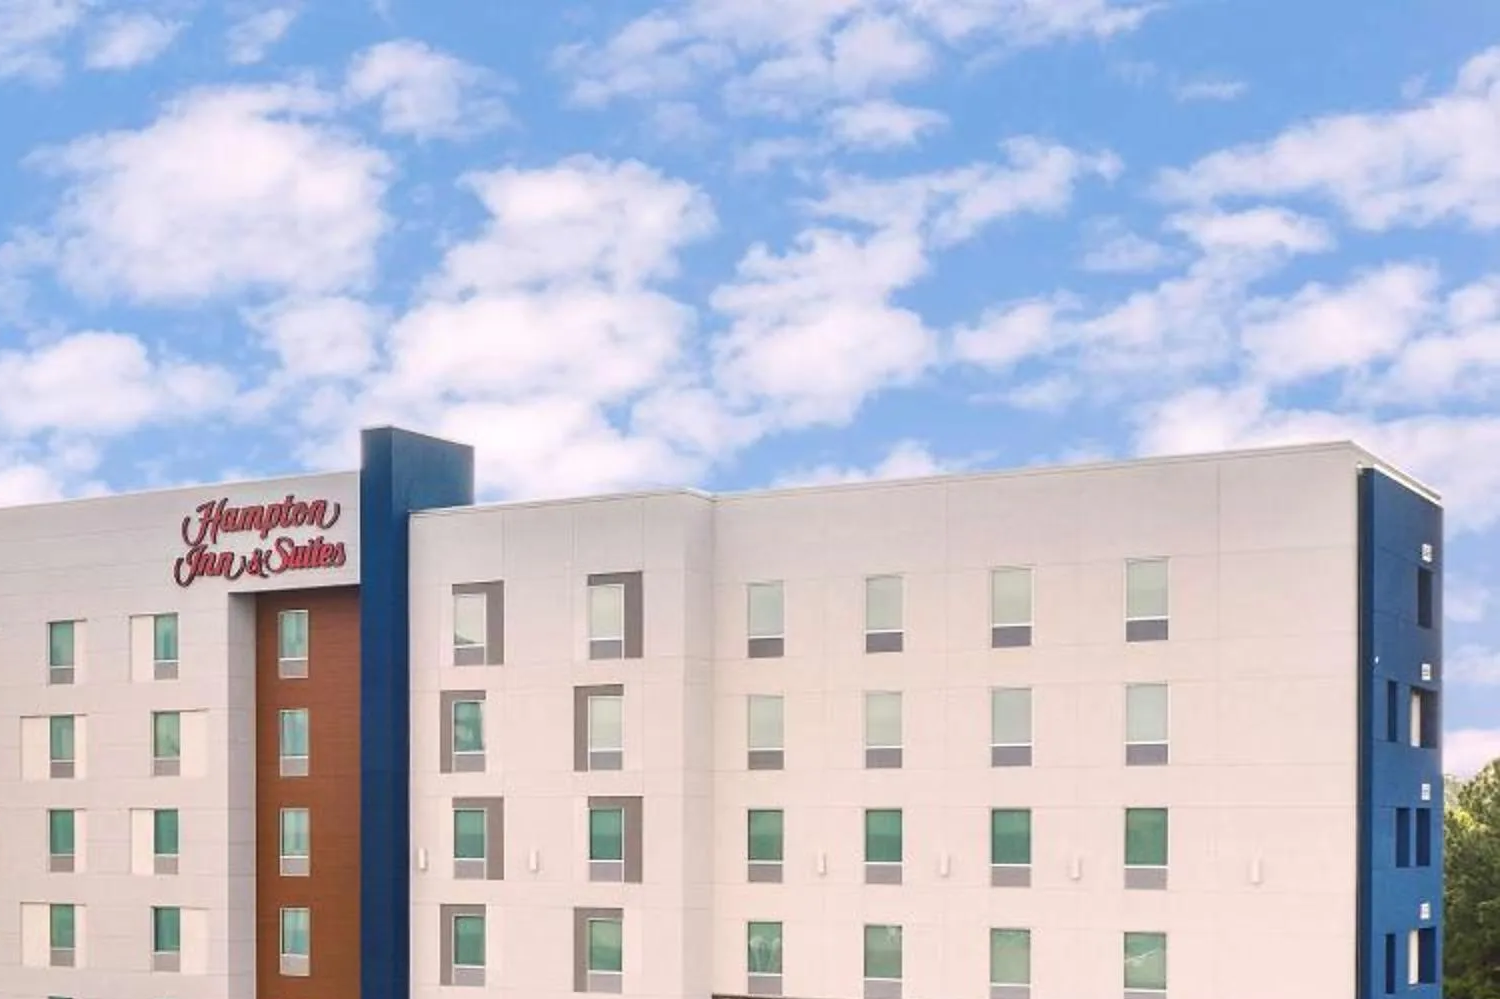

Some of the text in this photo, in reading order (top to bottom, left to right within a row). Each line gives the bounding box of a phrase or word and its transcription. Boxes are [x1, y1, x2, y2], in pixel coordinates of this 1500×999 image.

[181, 494, 341, 547] Hampton
[173, 535, 347, 588] Inn & Suites
